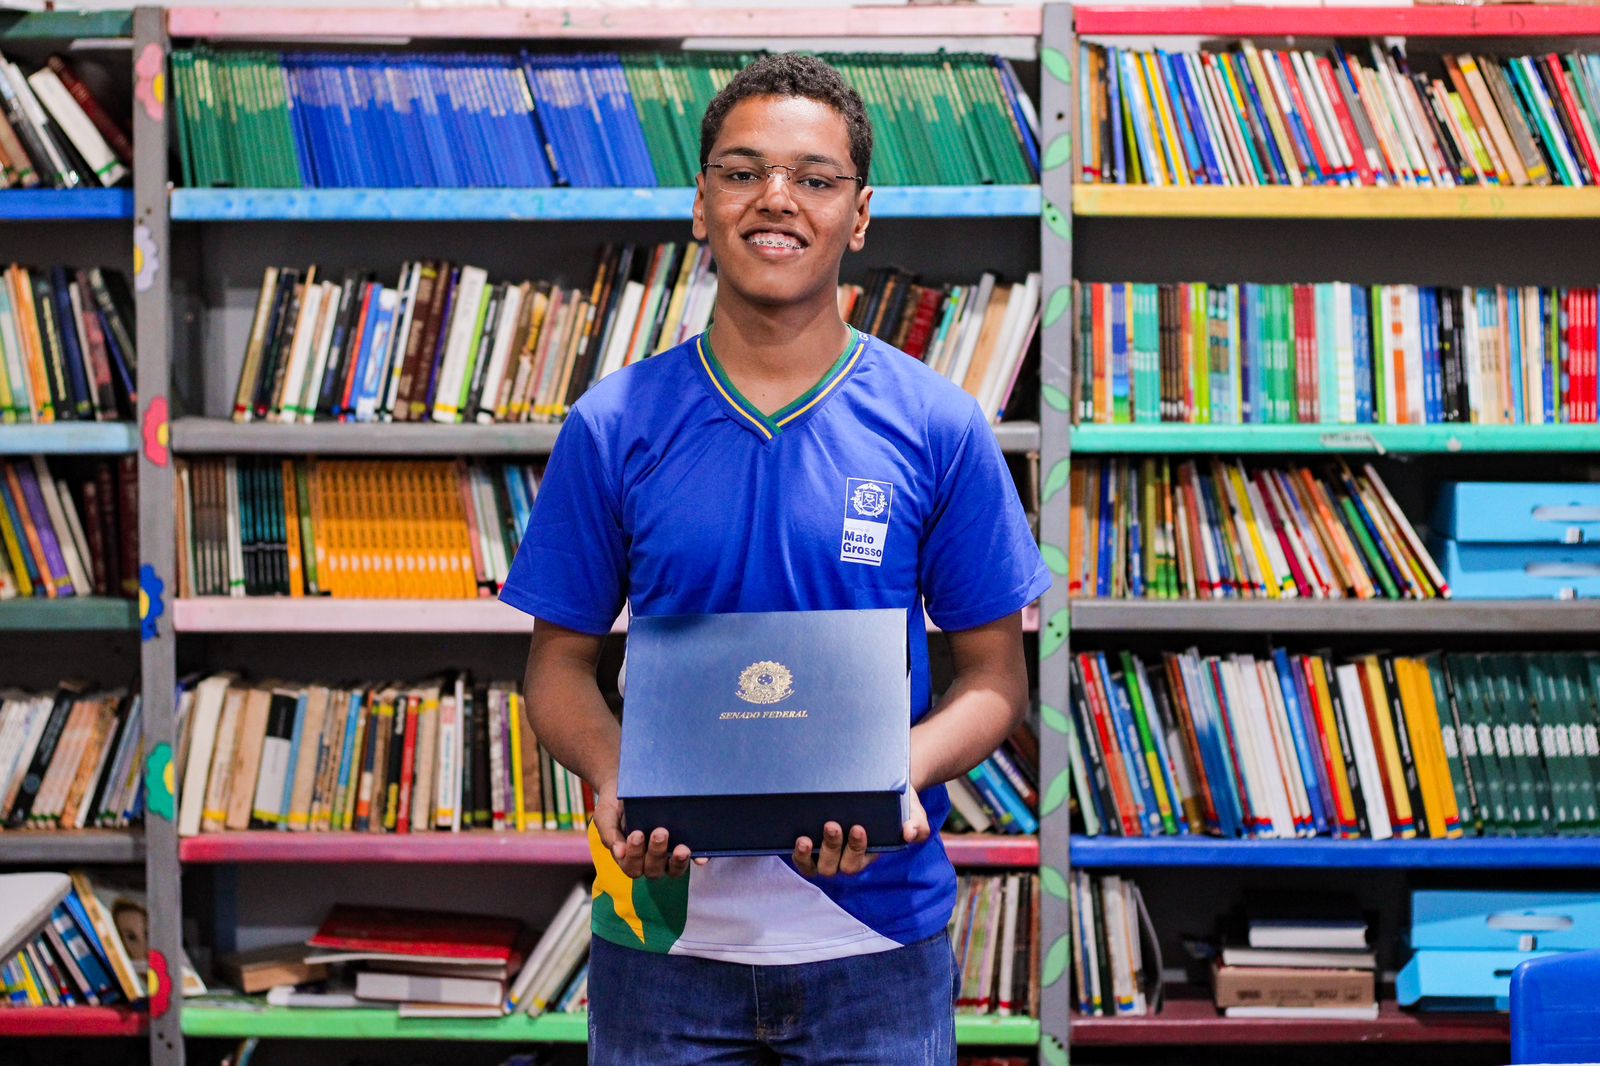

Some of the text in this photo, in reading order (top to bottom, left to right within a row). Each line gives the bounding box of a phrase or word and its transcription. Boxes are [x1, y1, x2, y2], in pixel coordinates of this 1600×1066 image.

[844, 530, 874, 544] Mato
[843, 542, 882, 557] Grosso
[719, 710, 808, 720] SENADO FEDERAL
